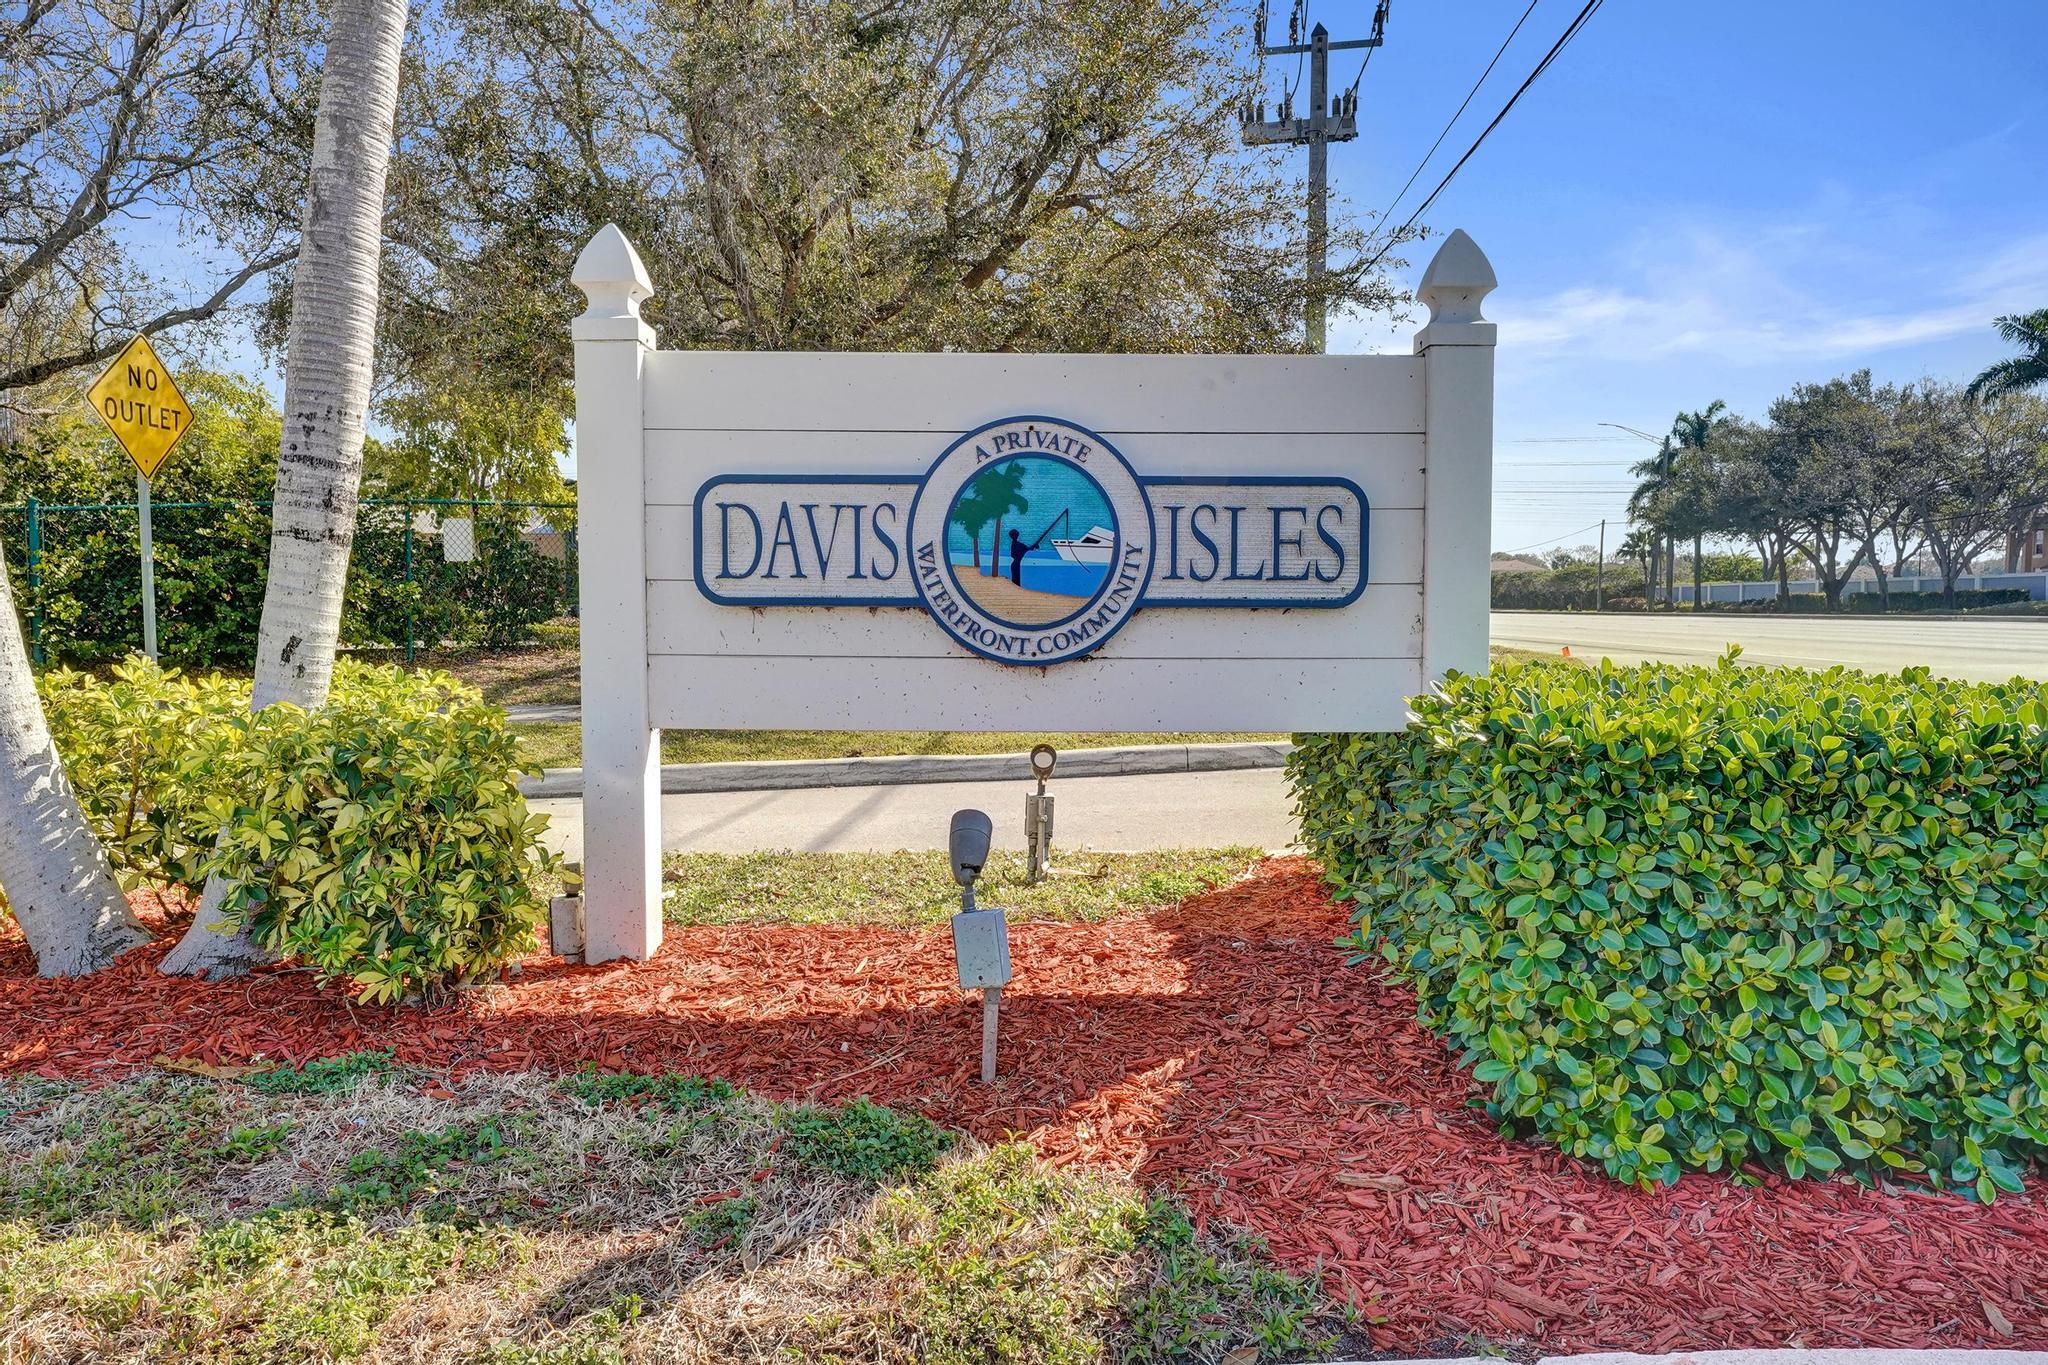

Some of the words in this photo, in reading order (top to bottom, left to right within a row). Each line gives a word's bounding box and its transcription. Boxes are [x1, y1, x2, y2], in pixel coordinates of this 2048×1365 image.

[127, 364, 157, 391] NO
[104, 396, 181, 432] OUTLET
[974, 444, 990, 464] A
[992, 430, 1092, 464] PRIVATE
[715, 501, 899, 581] DAVIS
[1162, 504, 1345, 582] ISLES
[917, 540, 1030, 655] WATERFRONT
[1036, 541, 1143, 654] COMMUNITY
